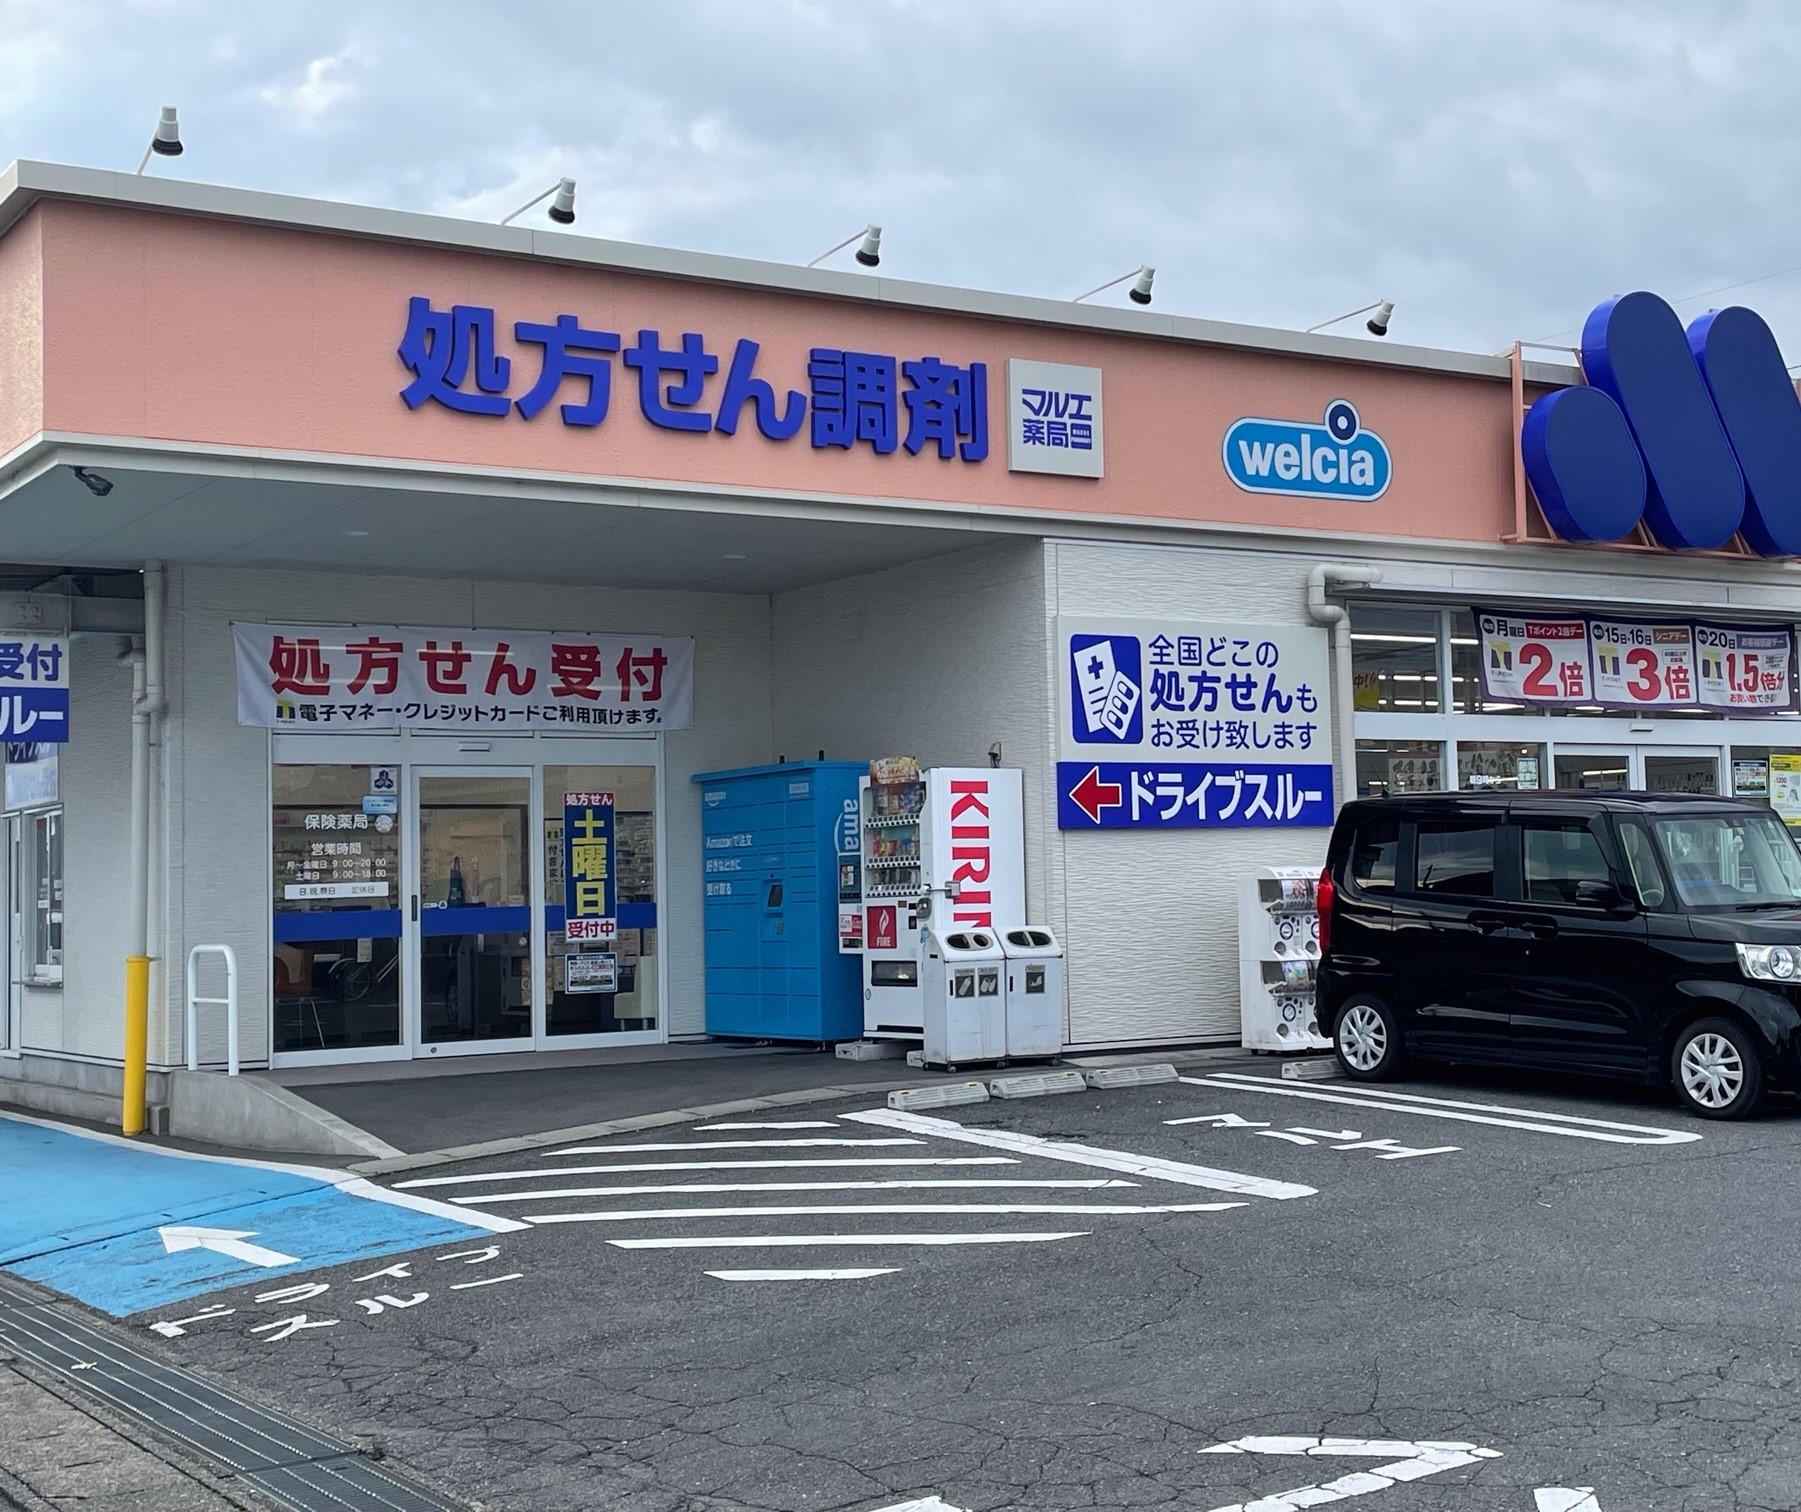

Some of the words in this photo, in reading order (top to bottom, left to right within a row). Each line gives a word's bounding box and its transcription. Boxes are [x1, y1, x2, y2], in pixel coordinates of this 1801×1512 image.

[397, 296, 989, 462] 処方せん調剤
[1021, 388, 1092, 421] マルエ
[1022, 418, 1069, 448] 薬局
[1238, 433, 1375, 487] welcia
[0, 642, 62, 681] 受付
[1149, 634, 1279, 668] 全国どこの
[269, 636, 668, 702] 処方せん受付
[1150, 668, 1318, 713] 処方せんも
[1151, 718, 1317, 750] お受け致します
[566, 794, 613, 806] 処方せん
[1130, 769, 1322, 821] ドライブスルー
[304, 814, 368, 830] 保険薬局
[311, 842, 361, 856] 営業時間
[572, 809, 608, 917] 土曜日
[568, 921, 615, 939] 受付中
